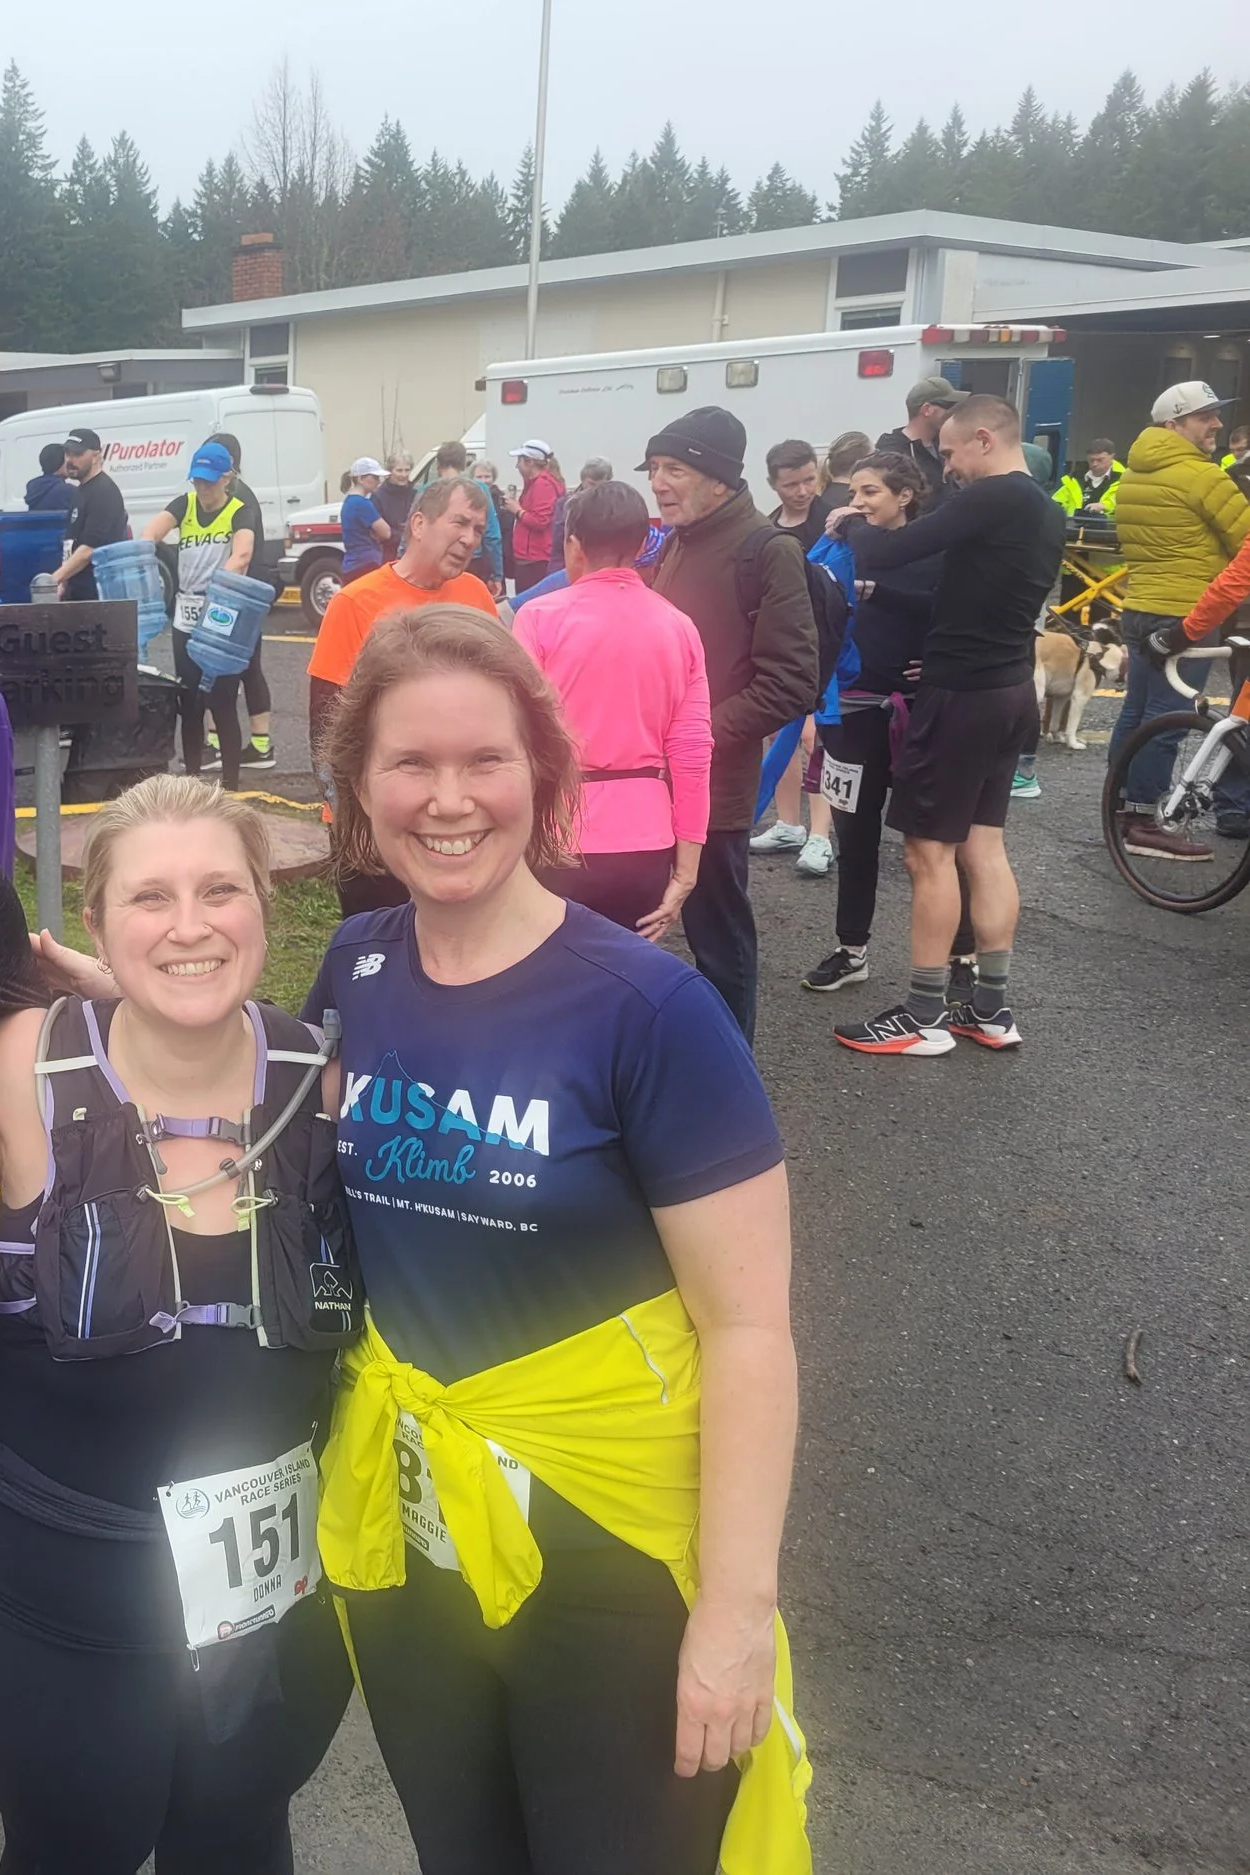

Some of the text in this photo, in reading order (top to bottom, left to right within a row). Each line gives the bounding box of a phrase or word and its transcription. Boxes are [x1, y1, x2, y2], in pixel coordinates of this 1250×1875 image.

[109, 439, 185, 460] Purolator
[340, 1072, 549, 1156] KUSAM
[337, 1139, 358, 1156] EST.
[365, 1135, 477, 1184] Klimb
[489, 1170, 537, 1188] 2006
[363, 1191, 391, 1206] TRAIL
[520, 1223, 538, 1232] BC
[314, 1301, 351, 1311] NATHAN
[214, 1458, 311, 1503] VANCOUVER ISLAND
[240, 1473, 302, 1506] RACE SERIES
[209, 1492, 300, 1589] 151
[401, 1502, 447, 1544] MAGGIE
[253, 1574, 282, 1603] DONNA
